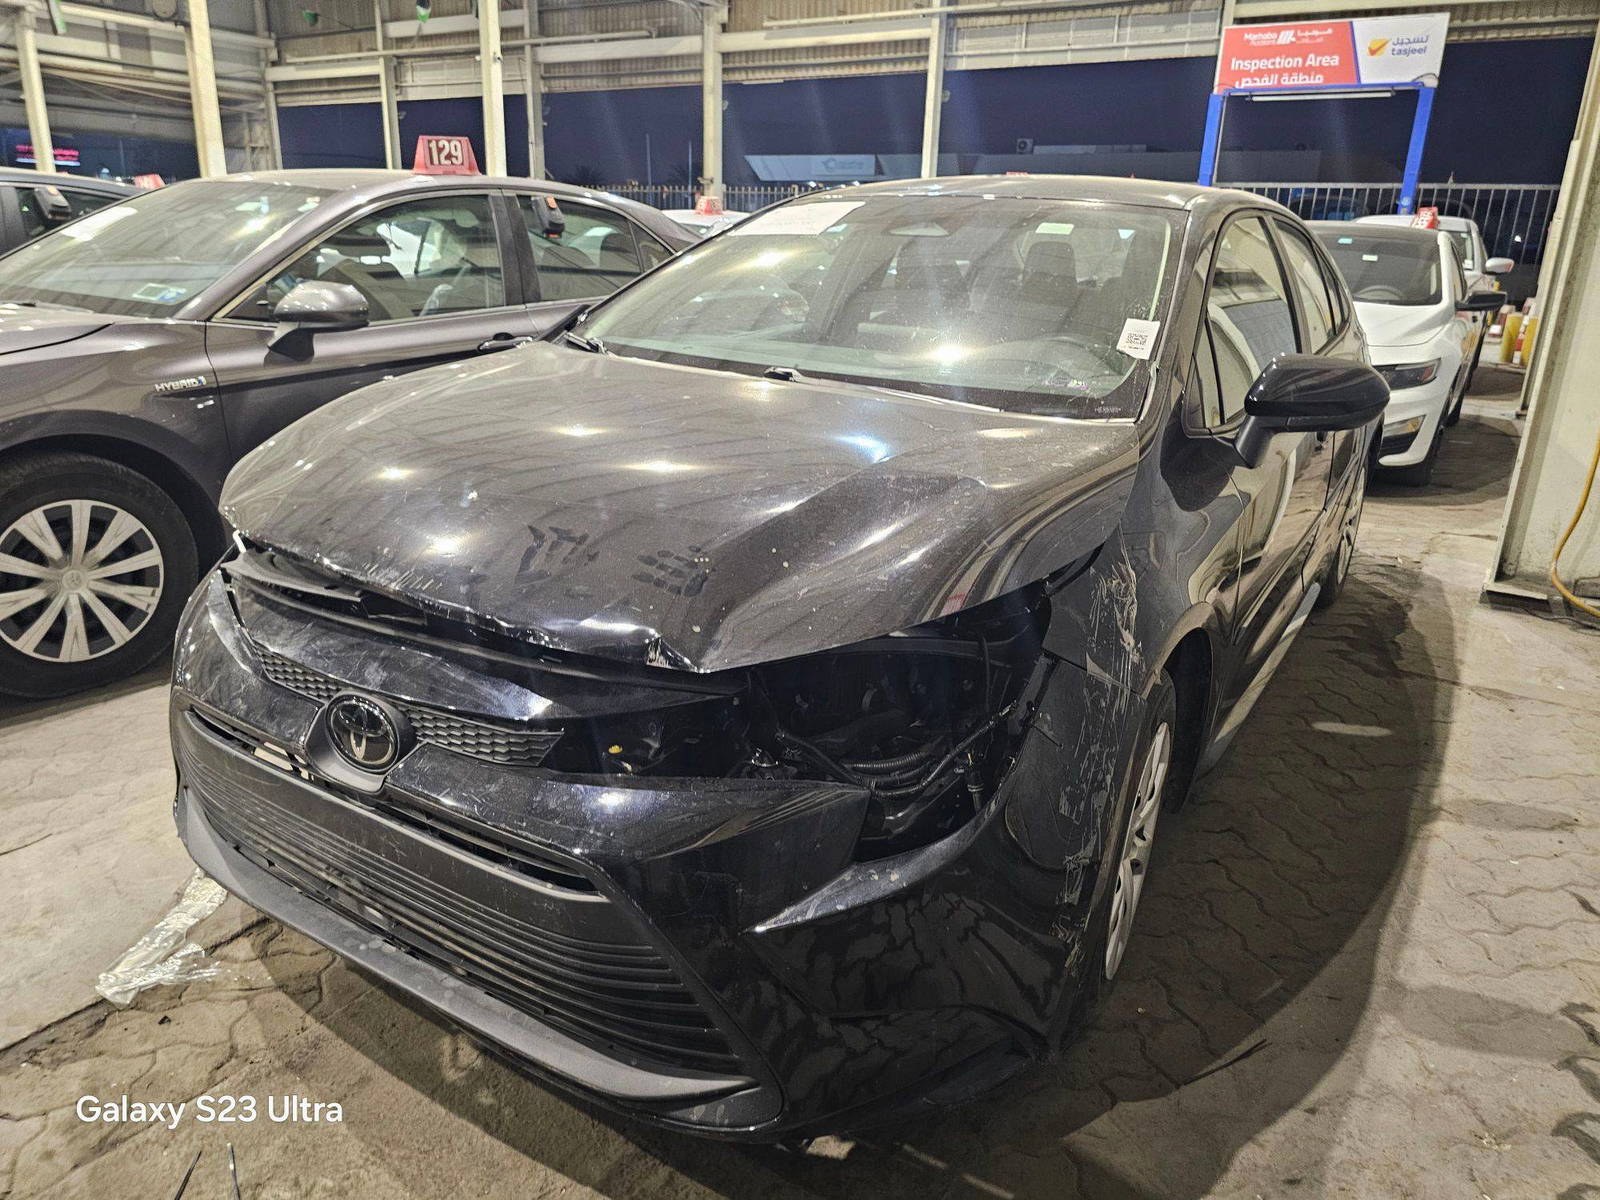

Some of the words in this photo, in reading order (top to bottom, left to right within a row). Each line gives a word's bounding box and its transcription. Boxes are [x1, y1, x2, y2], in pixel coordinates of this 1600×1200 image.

[1391, 34, 1429, 46] تسجيل
[1391, 46, 1428, 57] tasjeel
[1230, 55, 1303, 72] Inspection
[1305, 53, 1340, 67] Area
[1234, 74, 1278, 89] الفحص
[1280, 72, 1324, 85] منطقة
[428, 139, 464, 166] 129
[154, 378, 199, 392] HYBRID
